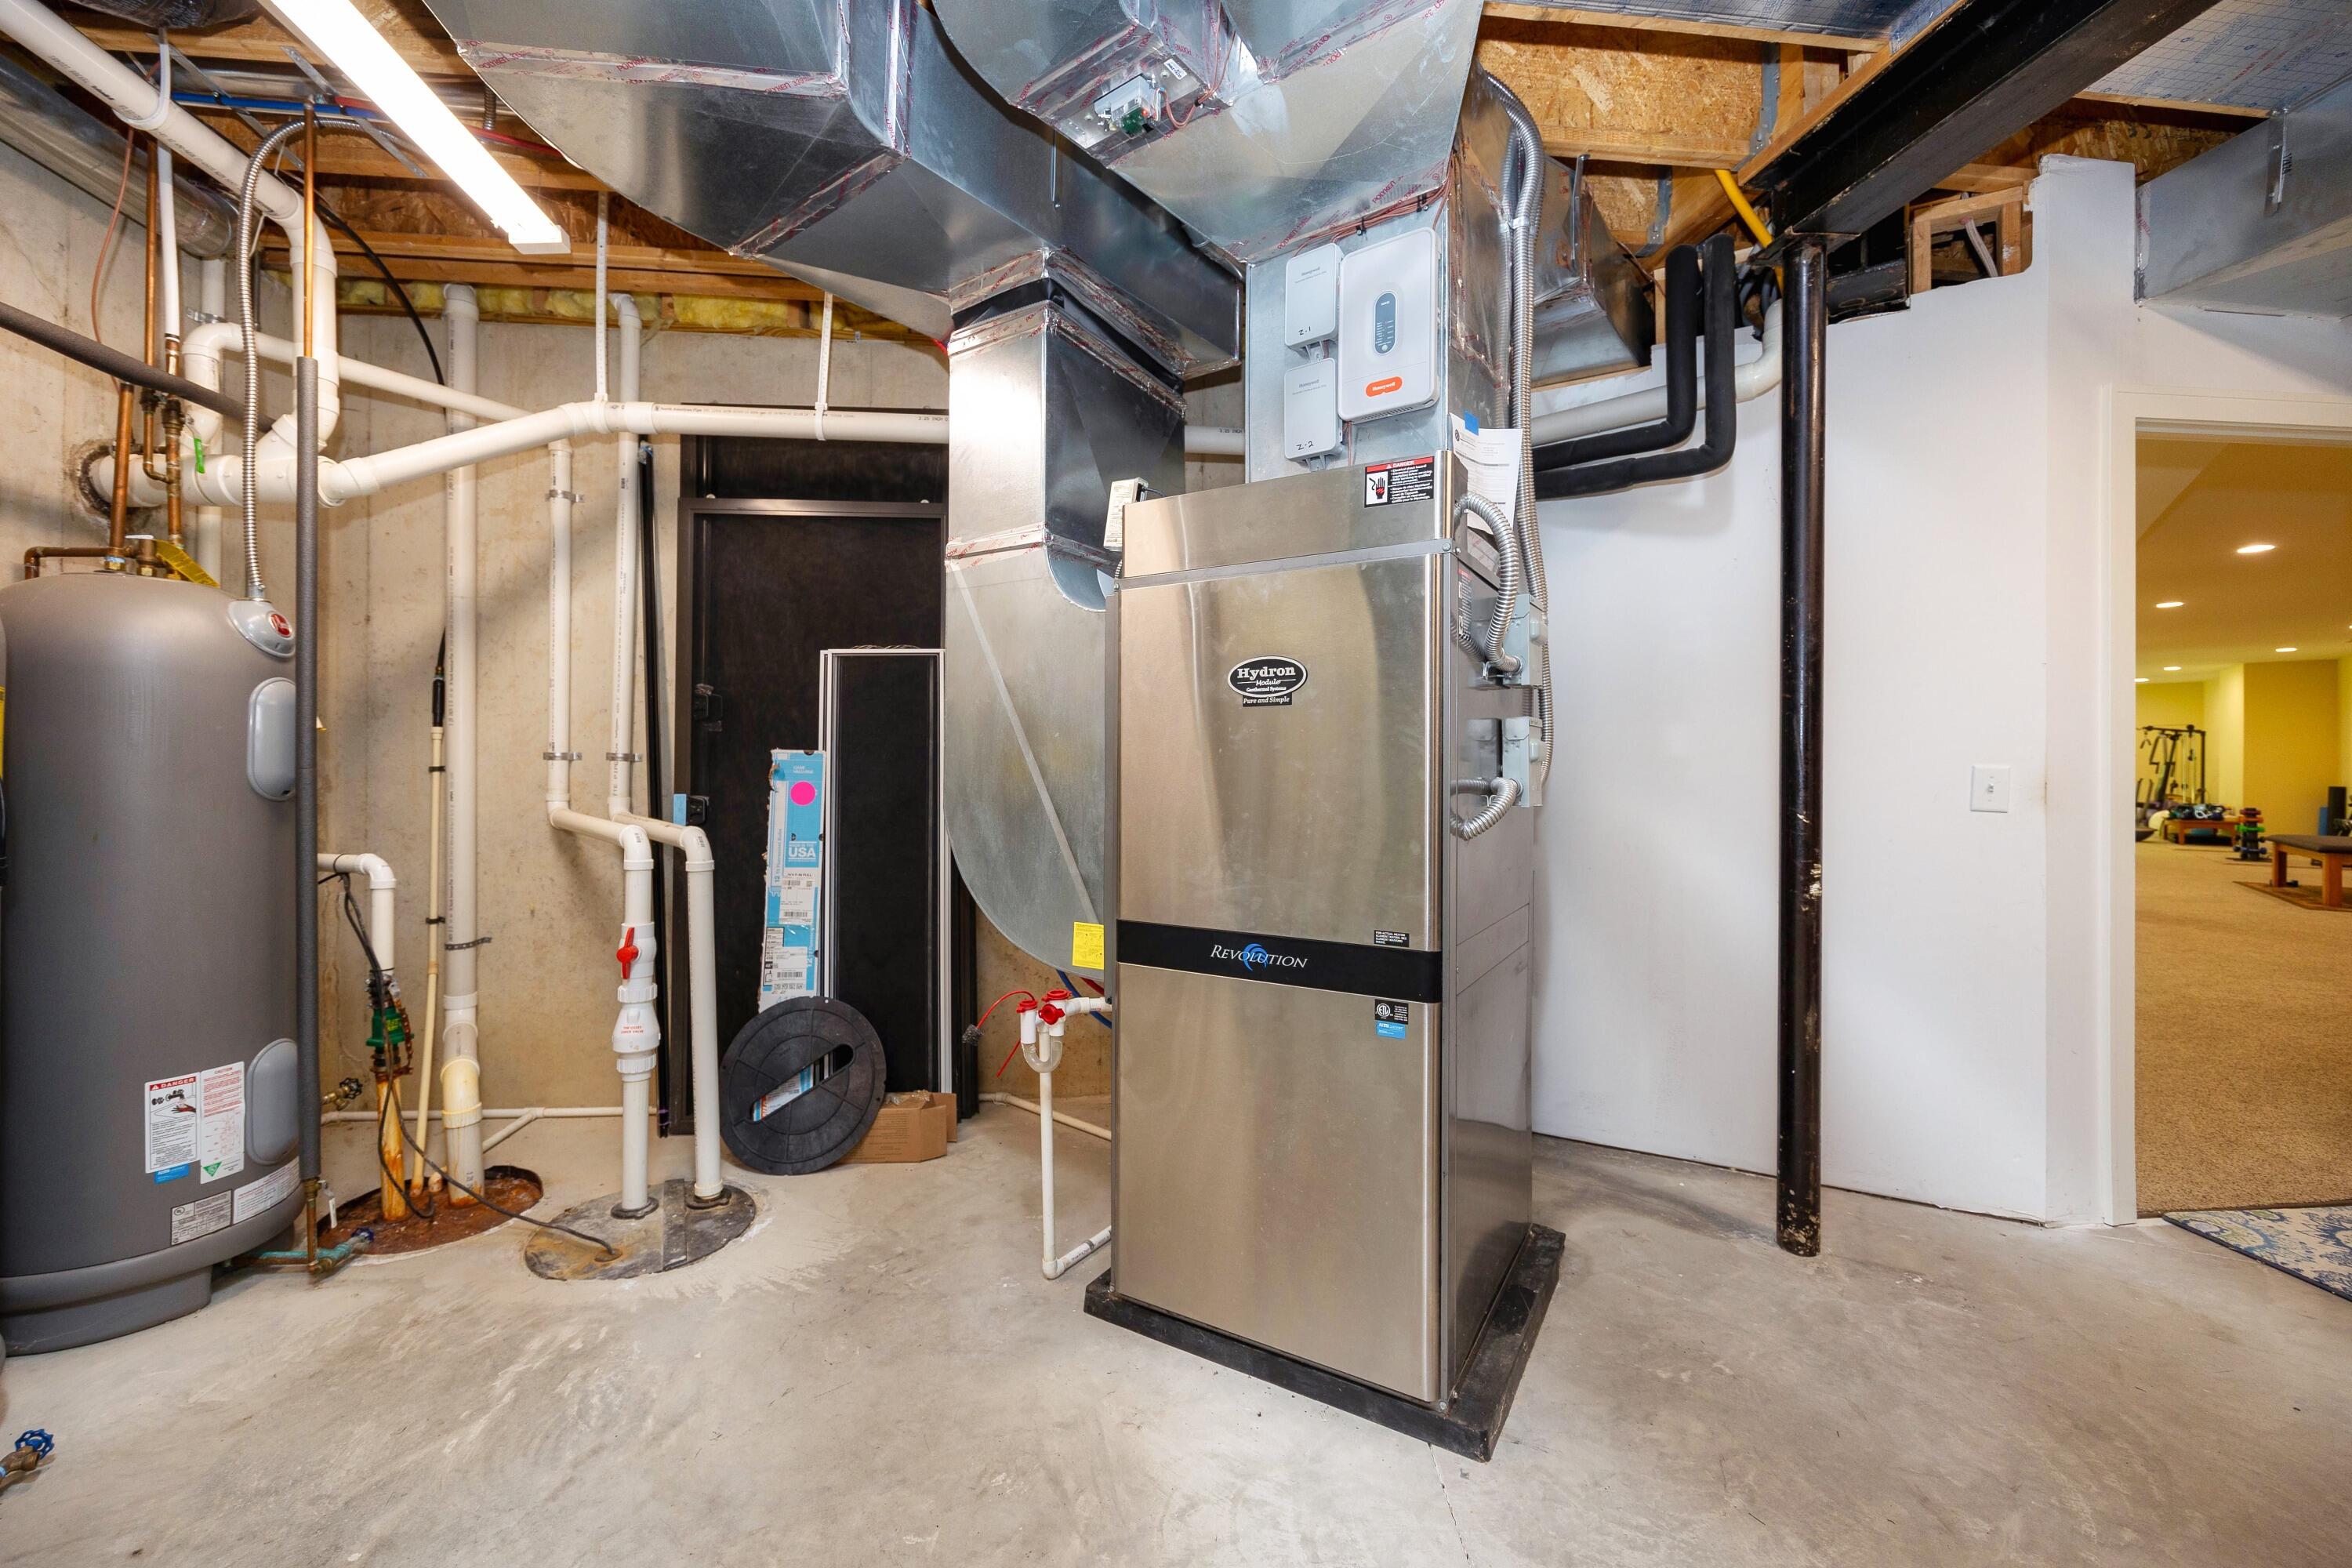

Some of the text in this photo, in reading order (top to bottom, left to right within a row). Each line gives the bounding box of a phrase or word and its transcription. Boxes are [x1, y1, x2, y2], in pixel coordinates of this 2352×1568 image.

[1373, 180, 1396, 204] POLYKEN
[1372, 381, 1396, 392] Honeywell
[1296, 441, 1314, 451] Z-2
[1237, 666, 1296, 681] Hydron
[788, 847, 816, 858] USA
[161, 1077, 195, 1088] DANGER
